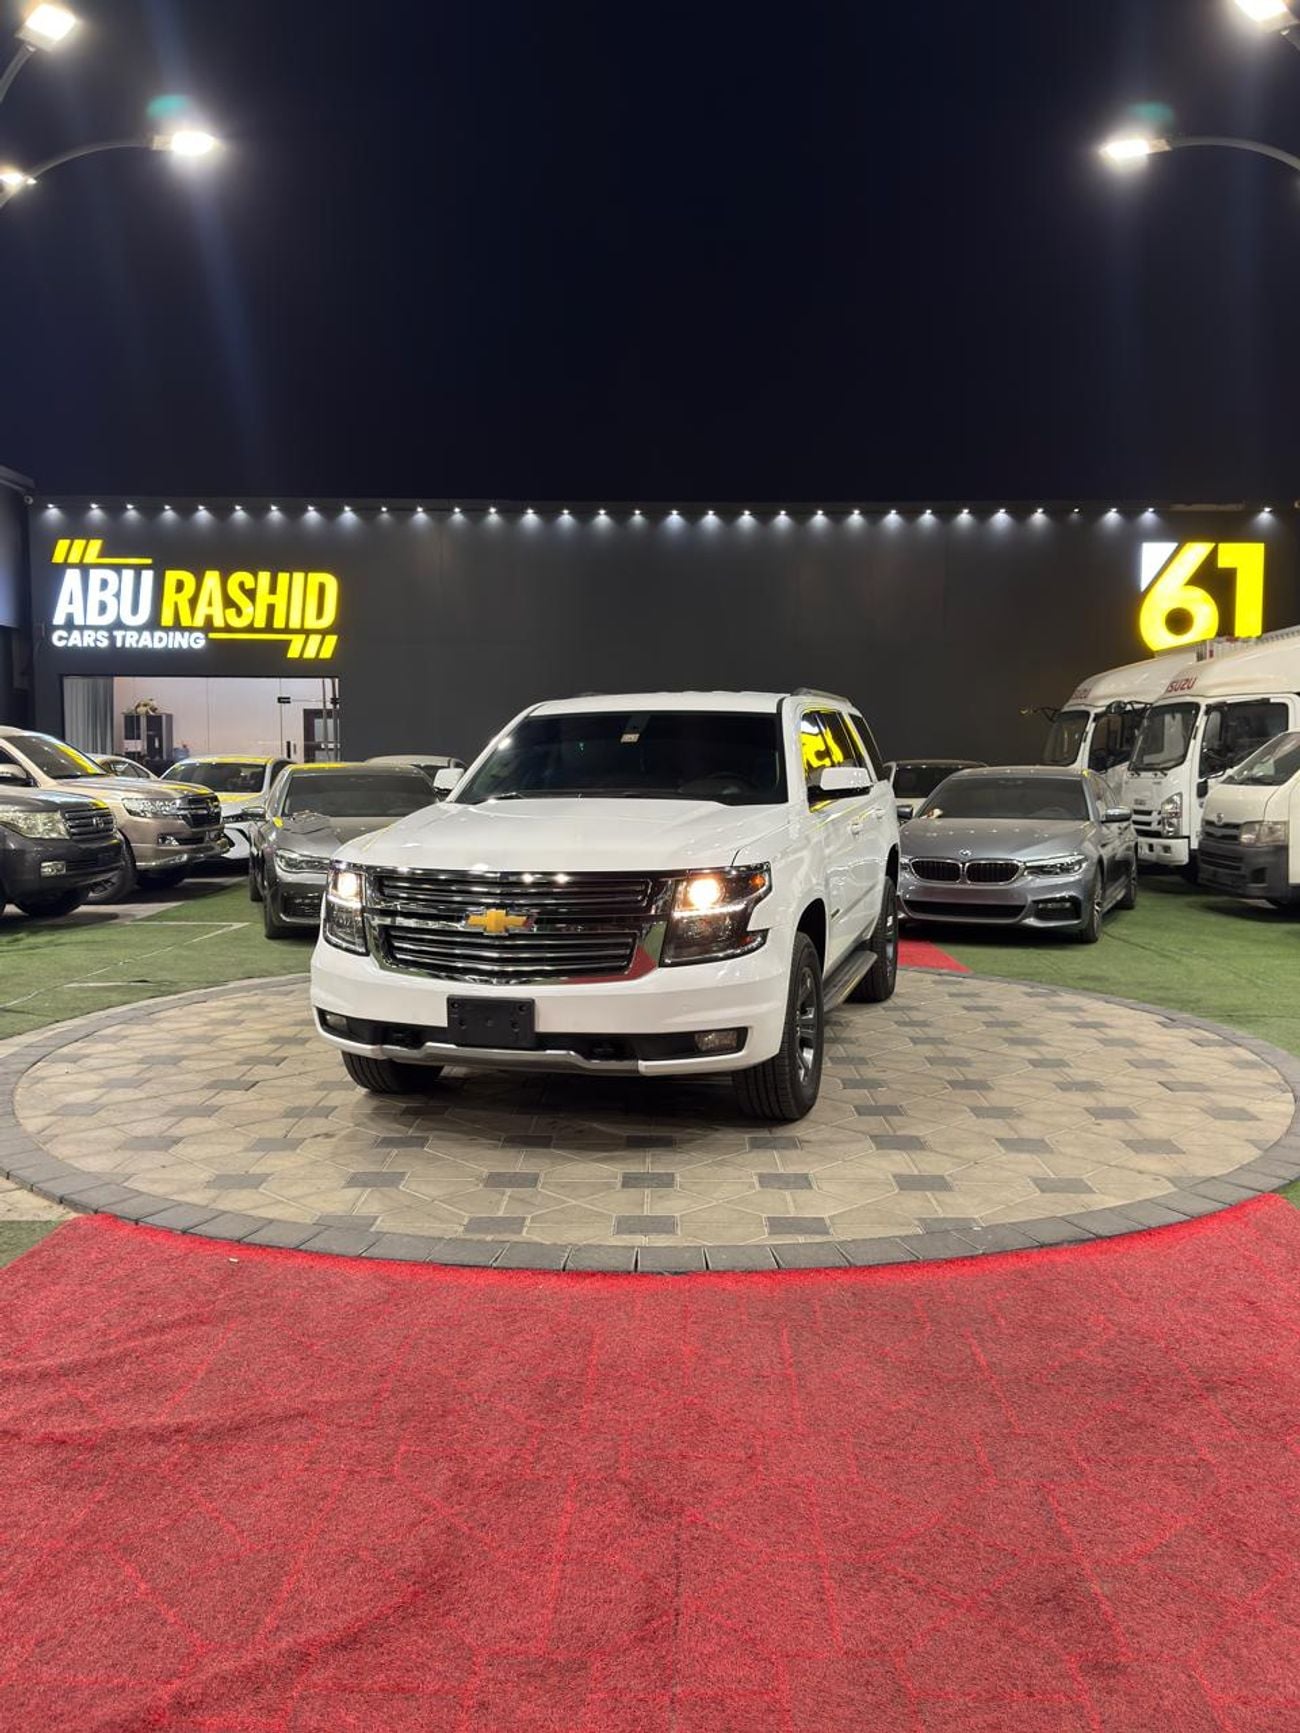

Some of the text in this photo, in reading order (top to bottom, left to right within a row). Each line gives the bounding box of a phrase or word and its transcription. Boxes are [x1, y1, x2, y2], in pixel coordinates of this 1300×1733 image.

[52, 568, 339, 630] ABU RASHID
[1139, 542, 1265, 651] 61
[51, 630, 206, 649] CARS TRADING
[1167, 677, 1198, 693] ISUZU
